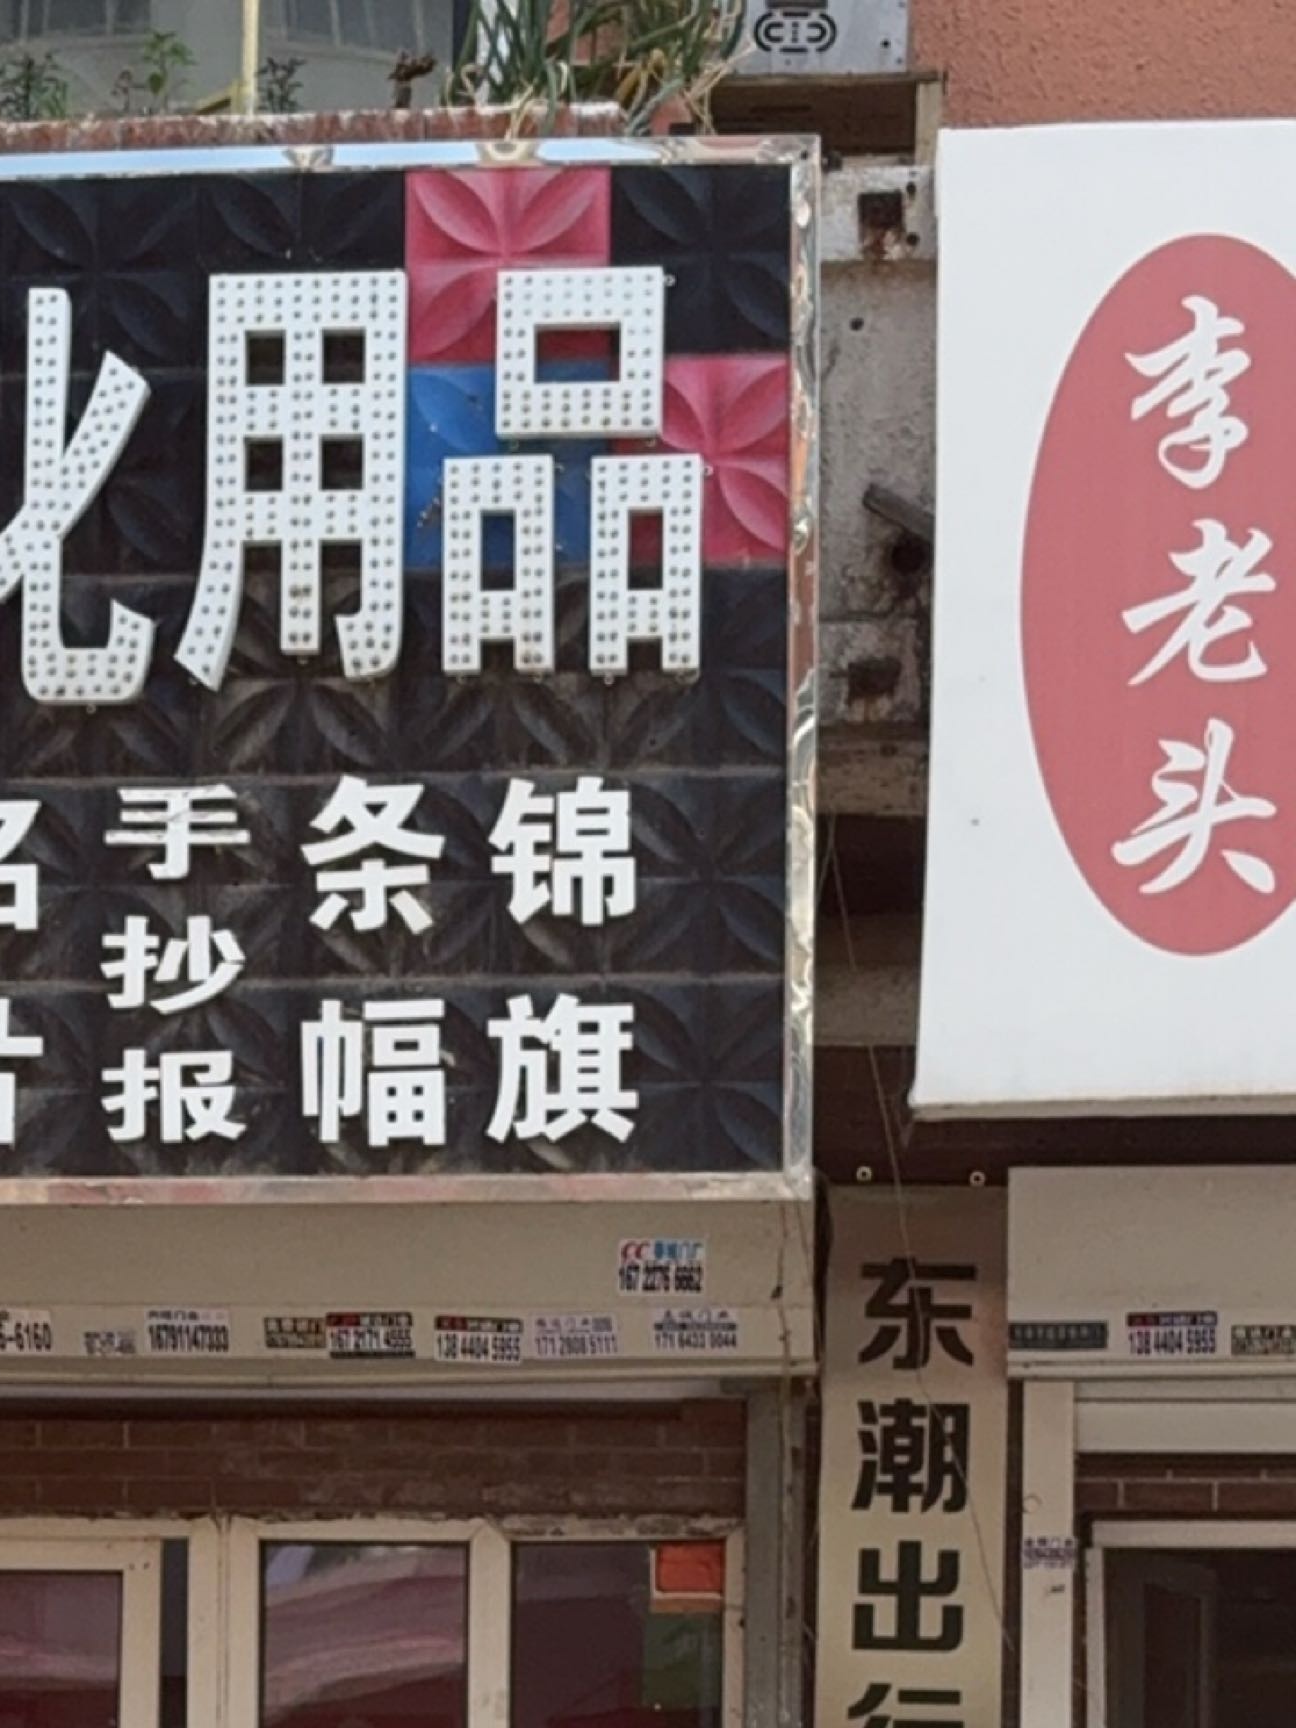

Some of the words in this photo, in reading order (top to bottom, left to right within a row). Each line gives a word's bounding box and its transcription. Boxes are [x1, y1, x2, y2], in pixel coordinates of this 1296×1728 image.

[1111, 295, 1277, 894] 李老头
[100, 783, 251, 1144] 手抄报
[300, 775, 446, 1148] 条幅
[485, 775, 640, 1144] 锦旗
